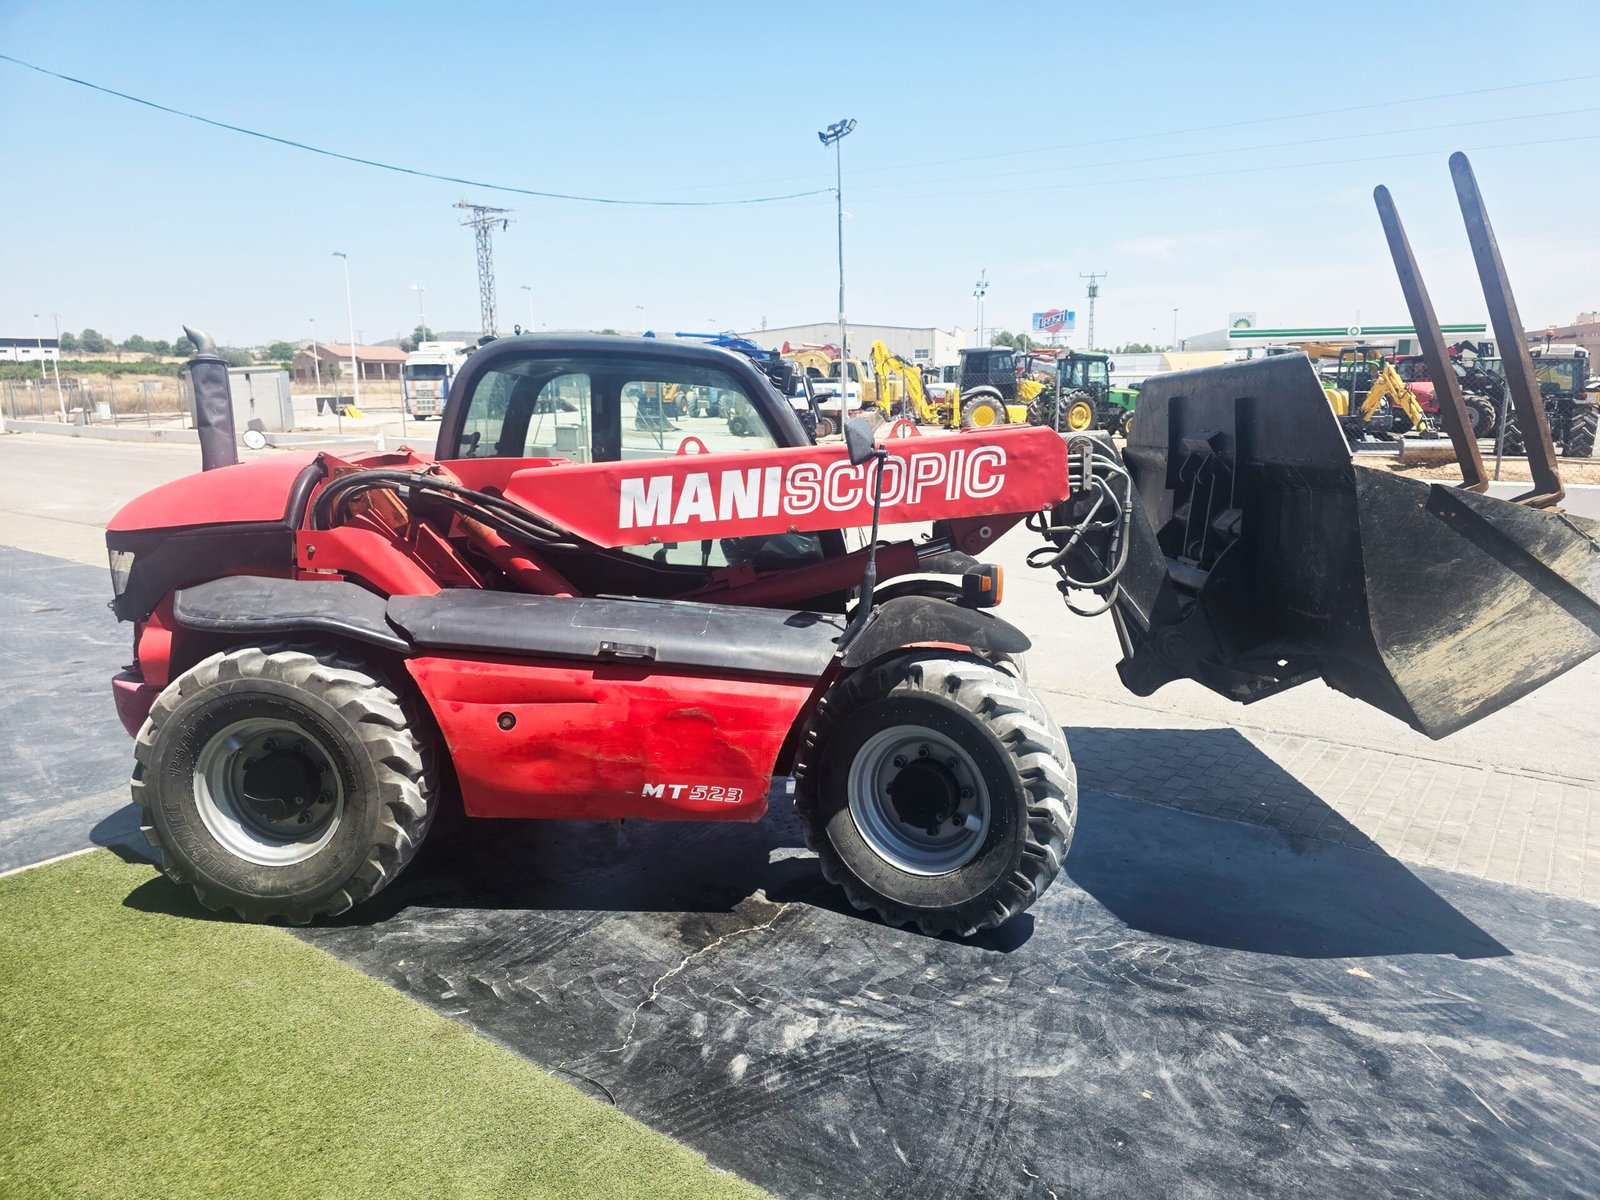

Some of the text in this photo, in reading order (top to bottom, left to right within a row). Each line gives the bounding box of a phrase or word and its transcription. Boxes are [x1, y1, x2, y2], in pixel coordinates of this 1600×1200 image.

[618, 445, 1007, 529] MANISCOPIC
[641, 783, 743, 804] MT 523
